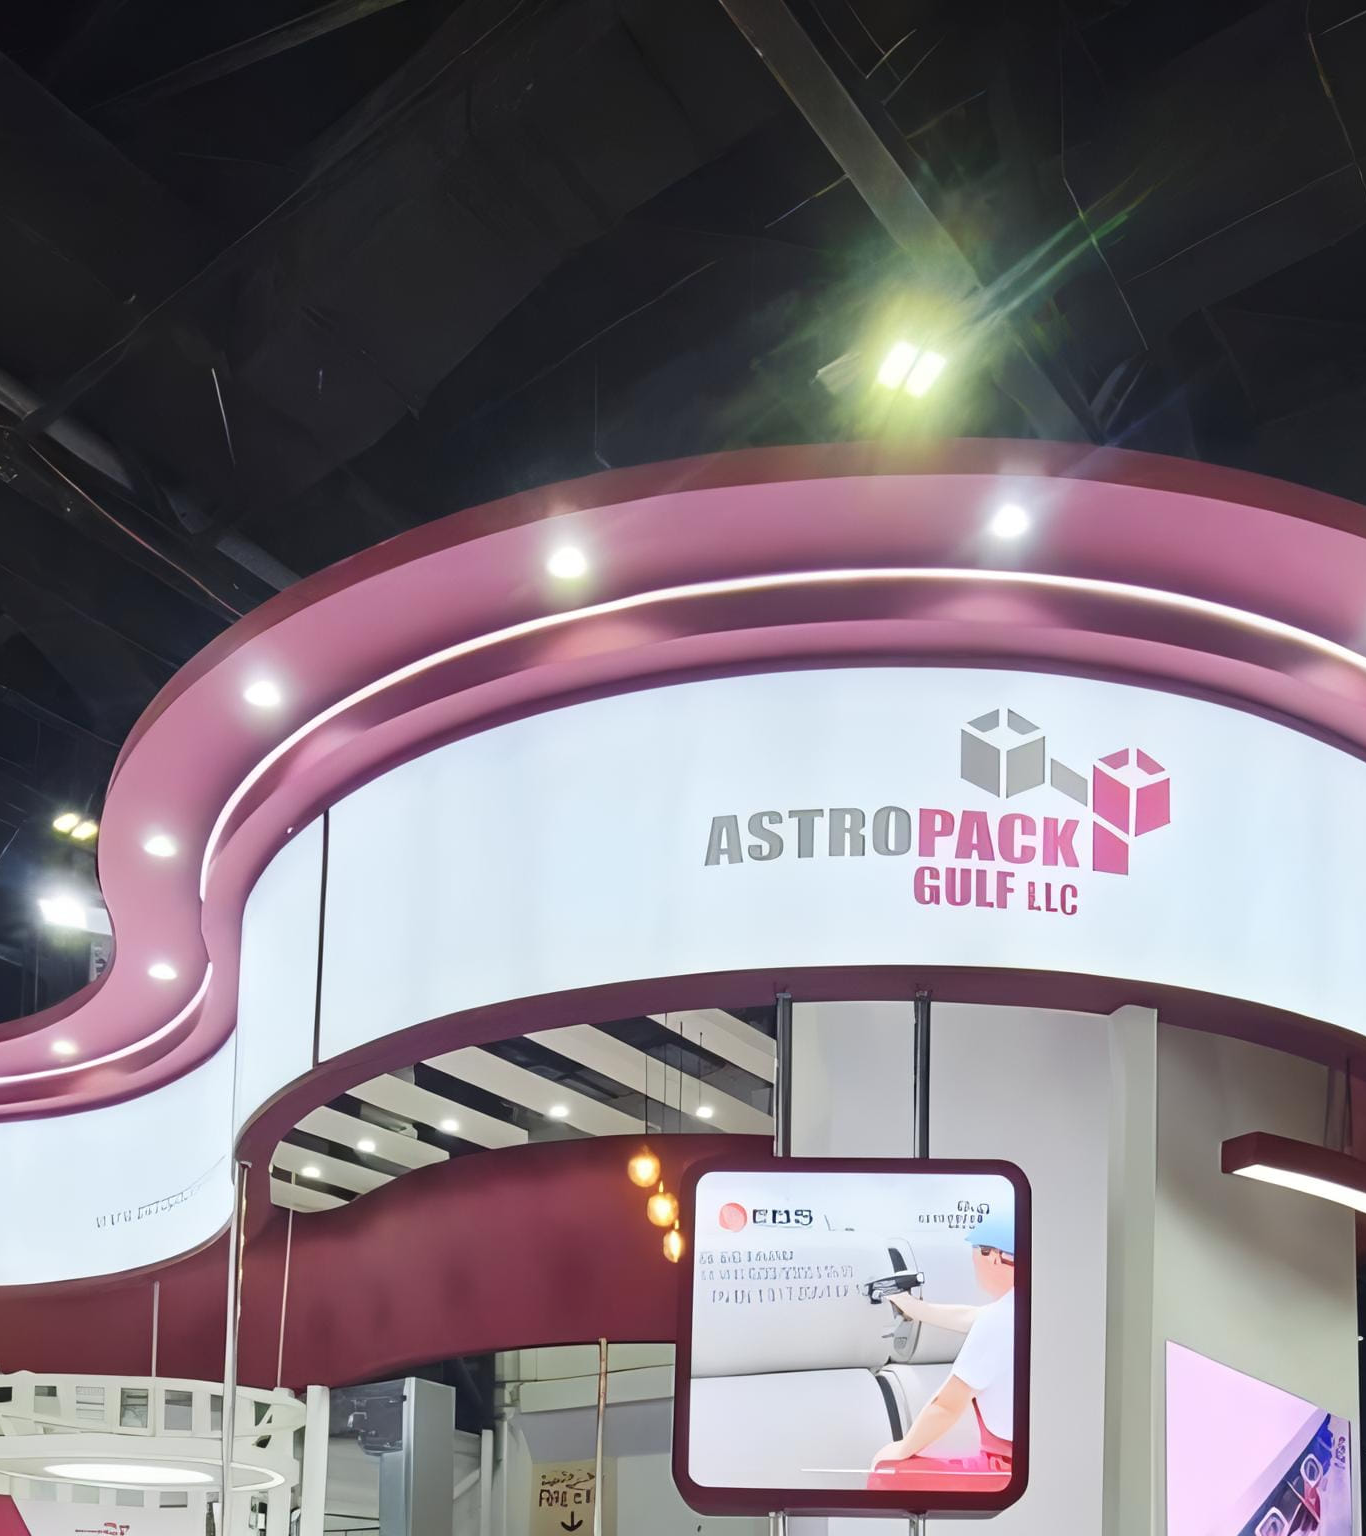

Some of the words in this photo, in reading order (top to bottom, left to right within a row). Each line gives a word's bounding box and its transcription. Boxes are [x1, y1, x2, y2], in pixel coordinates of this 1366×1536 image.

[703, 805, 1081, 868] ASTROPACK
[913, 866, 1016, 910] GULF
[1028, 880, 1079, 917] LLC
